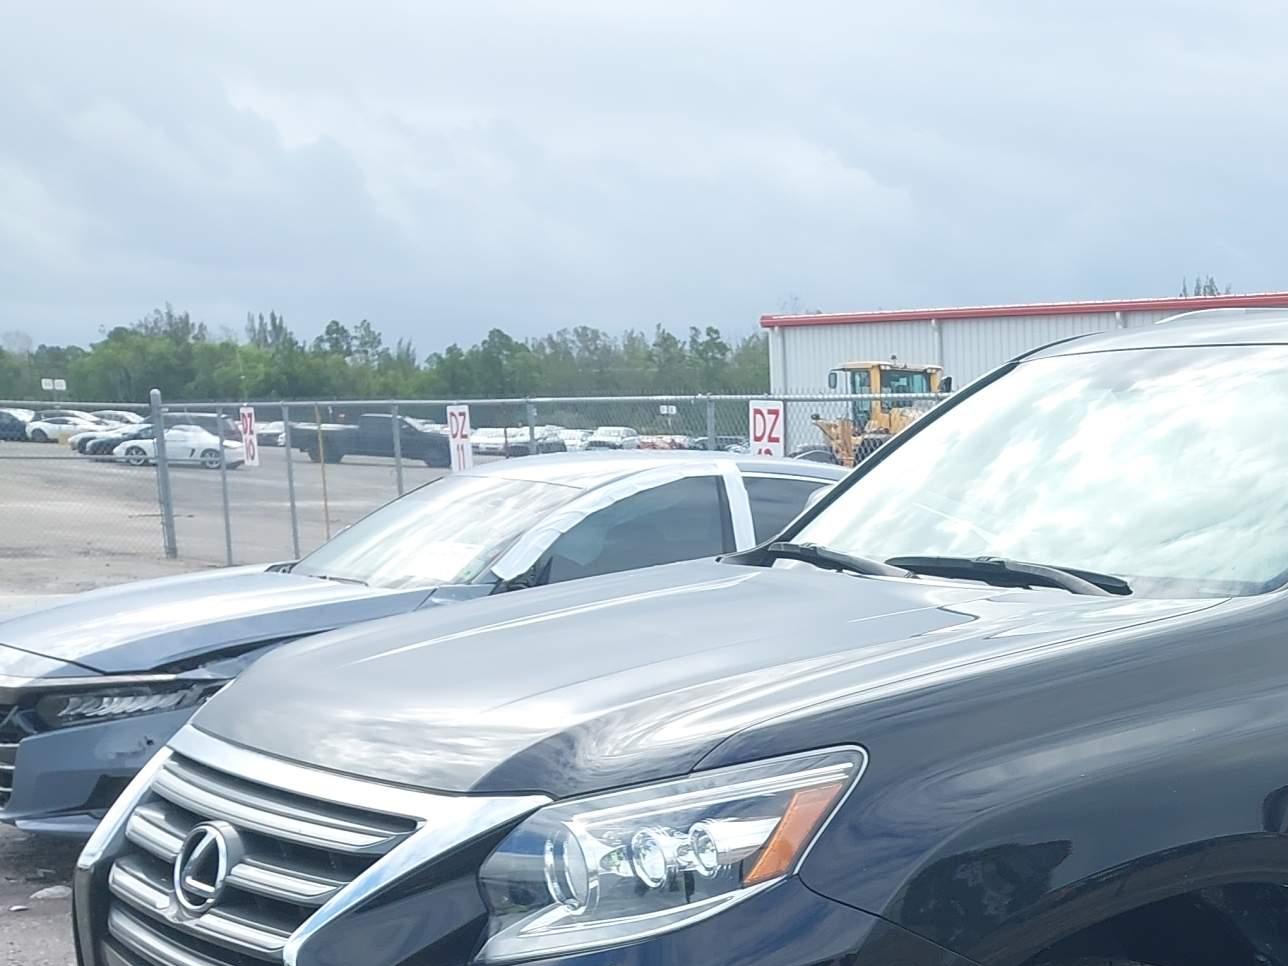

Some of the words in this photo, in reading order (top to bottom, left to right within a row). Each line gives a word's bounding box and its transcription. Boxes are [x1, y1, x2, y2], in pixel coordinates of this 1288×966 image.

[241, 413, 254, 435] DZ
[449, 411, 468, 439] DZ
[753, 408, 780, 443] DZ
